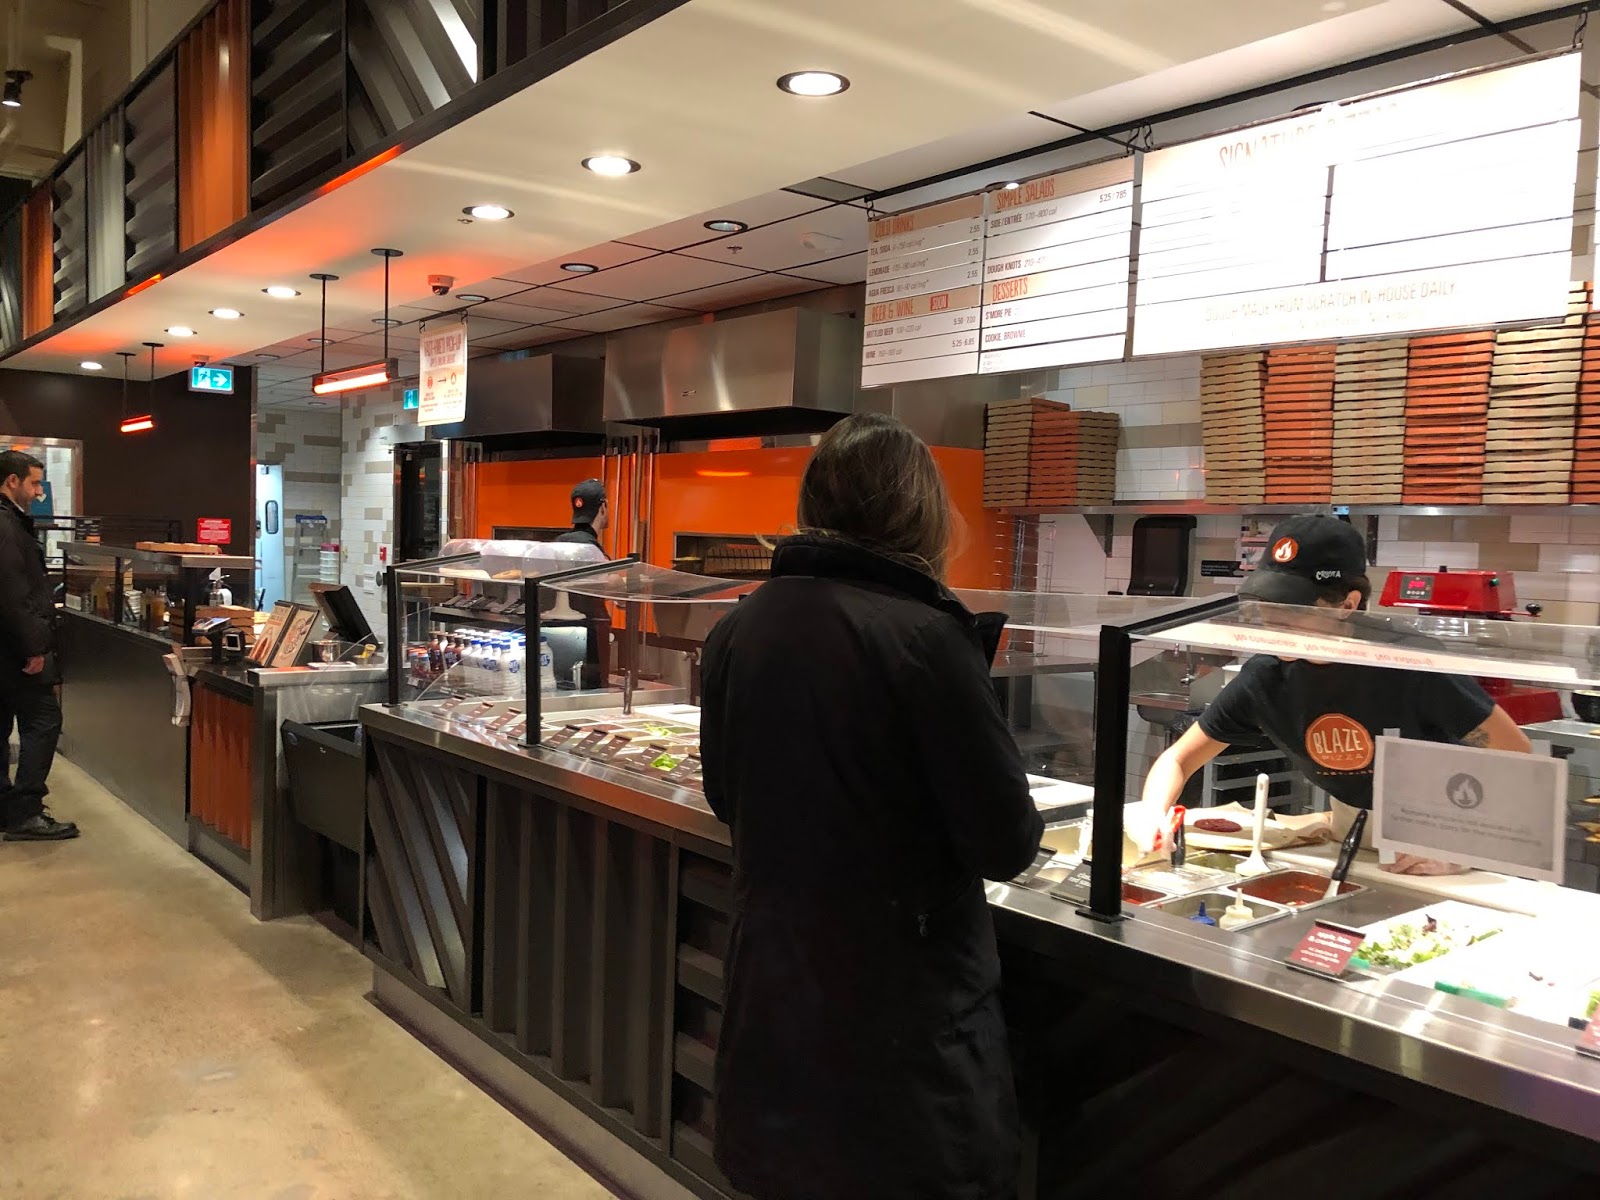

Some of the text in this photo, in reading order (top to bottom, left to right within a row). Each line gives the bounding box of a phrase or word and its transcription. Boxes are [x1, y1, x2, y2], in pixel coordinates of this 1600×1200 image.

[996, 178, 1055, 210] SIMPLE SALADS
[892, 215, 914, 235] DRINKS
[987, 263, 1004, 274] DOUGH
[1005, 259, 1021, 271] KNOTS
[993, 277, 1028, 301] DESSERTS
[872, 303, 886, 322] BEER
[896, 298, 914, 317] WINE
[1313, 727, 1364, 754] BLAZE
[1321, 753, 1363, 761] PIZZA
